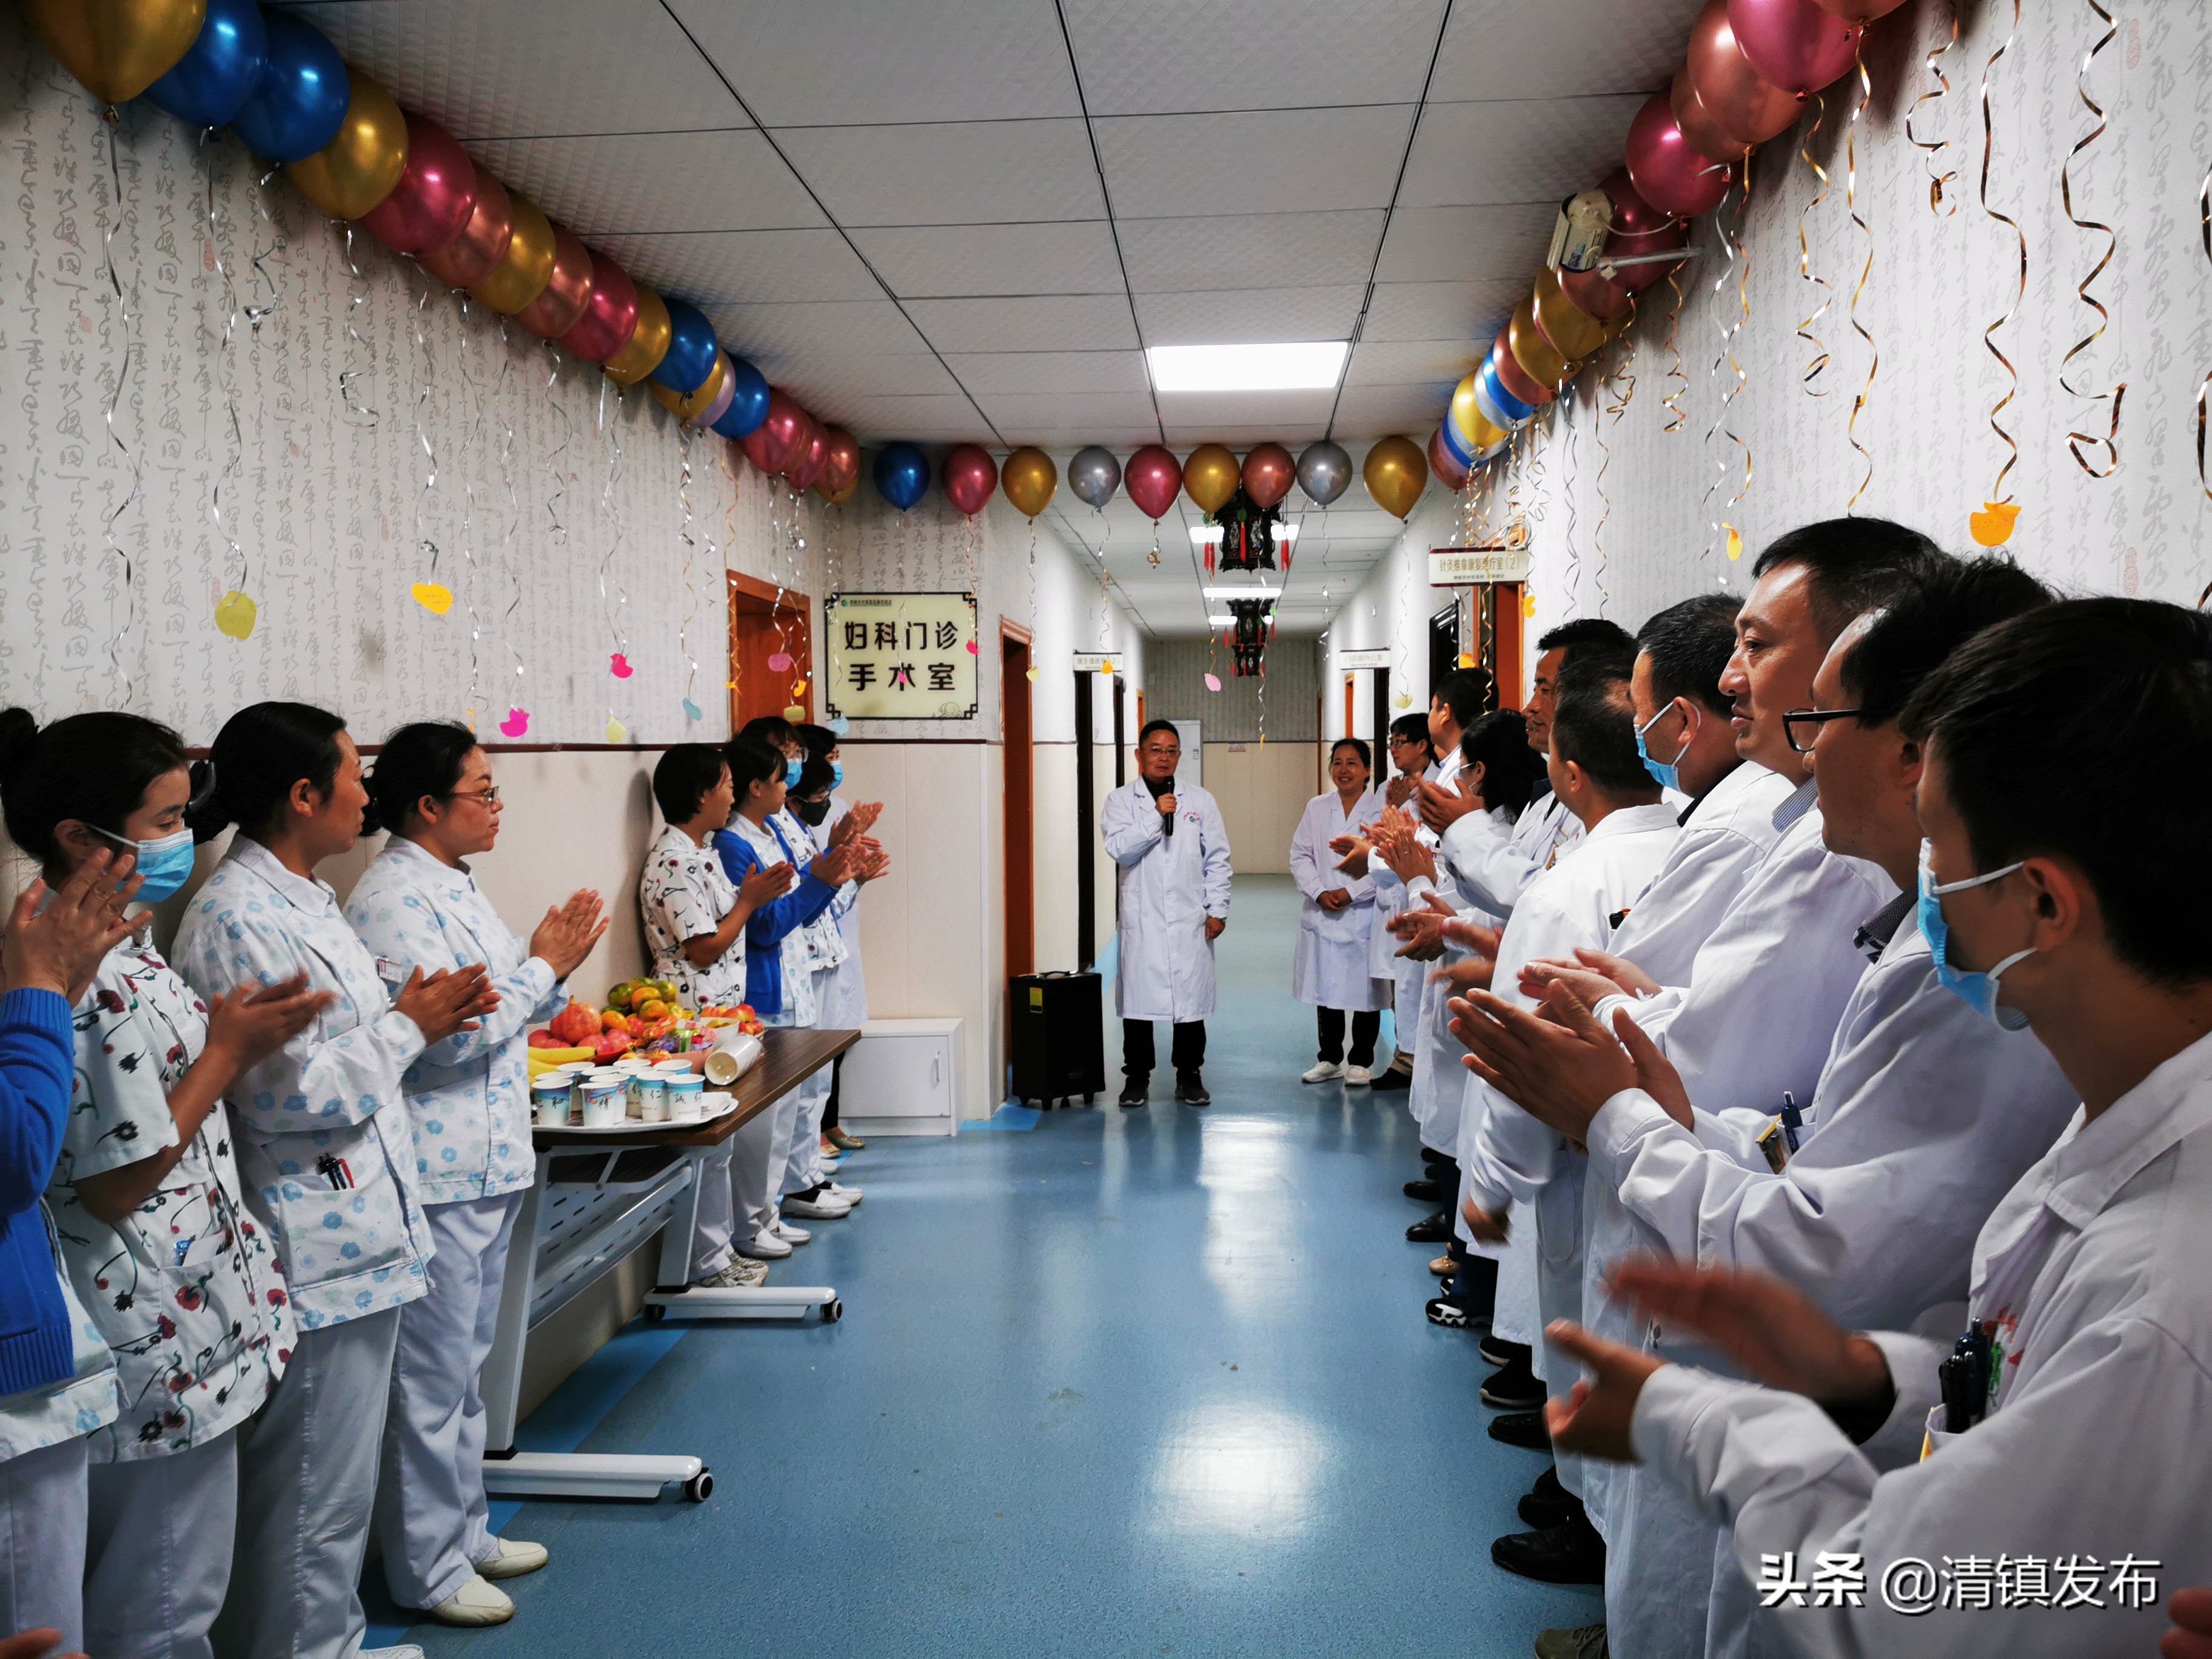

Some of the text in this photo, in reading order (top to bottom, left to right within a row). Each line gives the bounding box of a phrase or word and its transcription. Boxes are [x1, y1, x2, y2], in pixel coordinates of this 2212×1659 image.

[844, 621, 958, 651] 妇科门诊
[848, 662, 956, 691] 手术室
